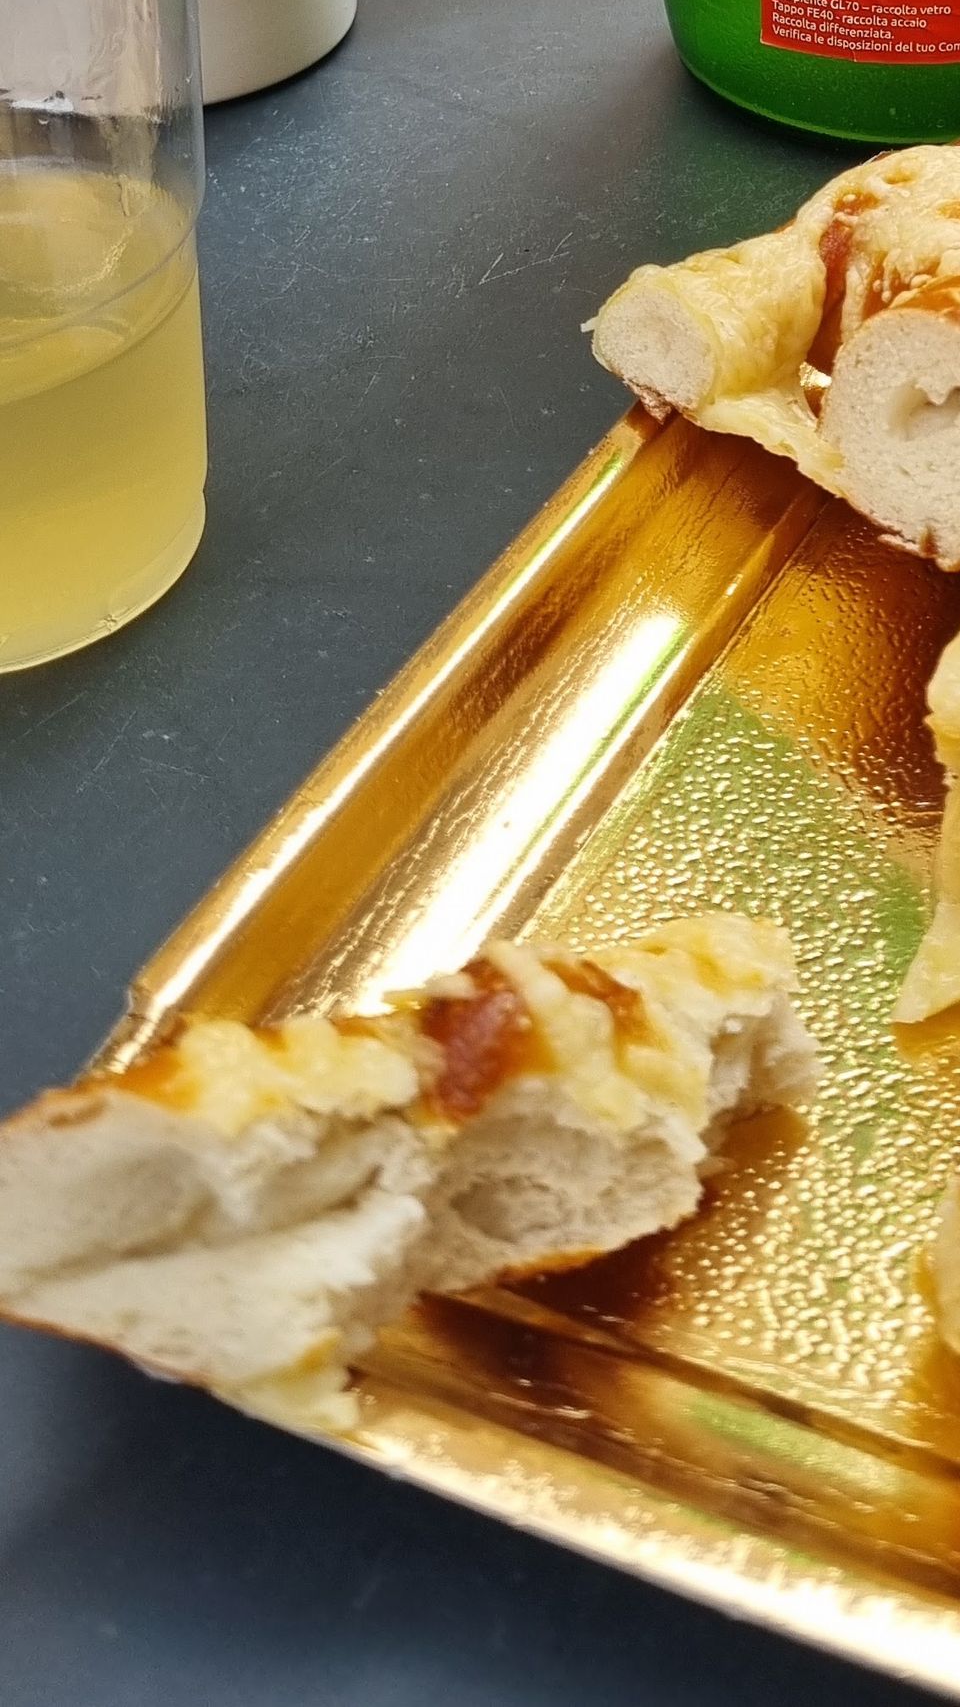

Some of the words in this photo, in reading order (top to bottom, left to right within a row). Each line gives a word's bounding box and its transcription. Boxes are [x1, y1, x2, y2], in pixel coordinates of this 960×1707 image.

[772, 0, 804, 15] Tappo
[807, 7, 833, 20] FE40
[842, 15, 888, 26] raccolta
[871, 4, 917, 15] raccolta
[920, 5, 951, 15] vetro
[772, 12, 816, 30] Raccolta
[819, 21, 894, 39] differenziata.
[773, 25, 811, 42] Verifica
[814, 33, 824, 44] le
[827, 35, 892, 51] disposizioni
[895, 41, 913, 52] del
[916, 43, 936, 52] tuo
